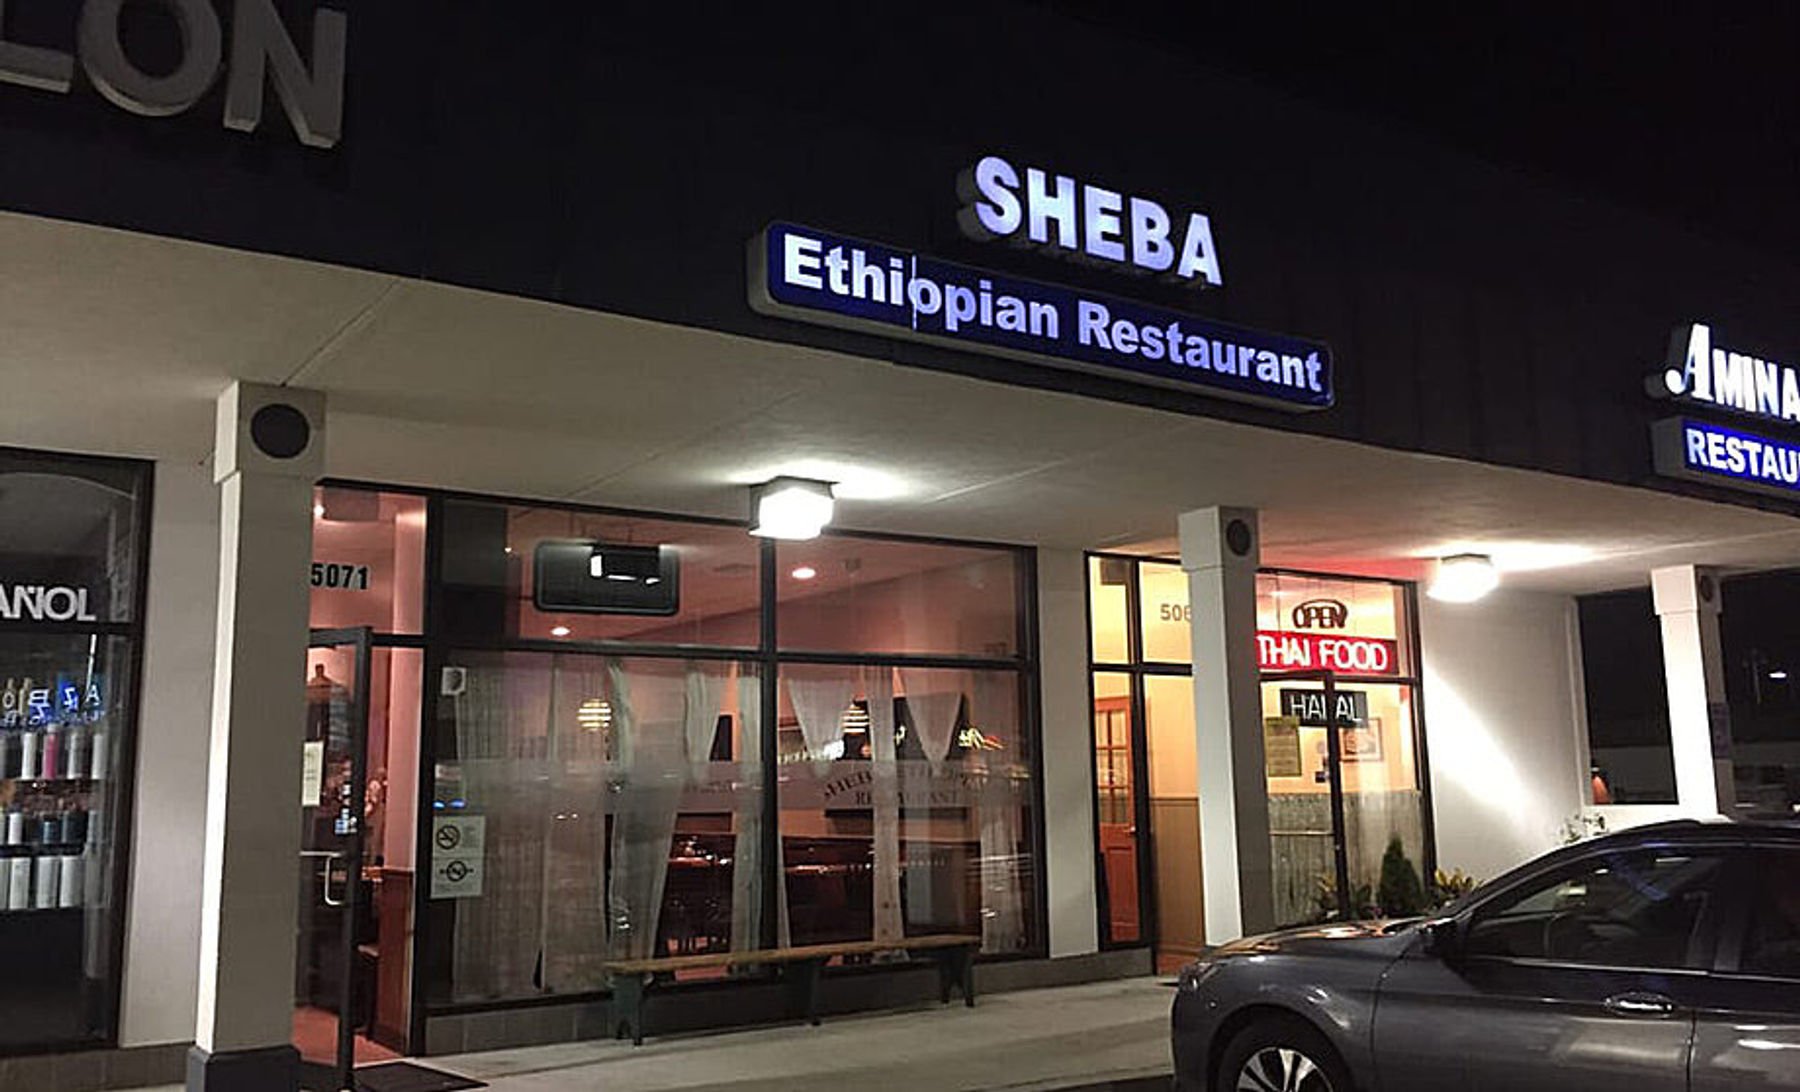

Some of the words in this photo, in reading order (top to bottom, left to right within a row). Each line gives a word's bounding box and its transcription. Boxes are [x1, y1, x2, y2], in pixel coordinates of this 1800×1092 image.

[975, 156, 1223, 286] SHEBA
[784, 233, 1059, 339] Ethiopian
[1078, 300, 1322, 392] Restaurant
[310, 562, 367, 590] 5071
[1293, 599, 1348, 629] OPEN
[1257, 635, 1311, 666] THAI
[1319, 640, 1388, 670] FOOD
